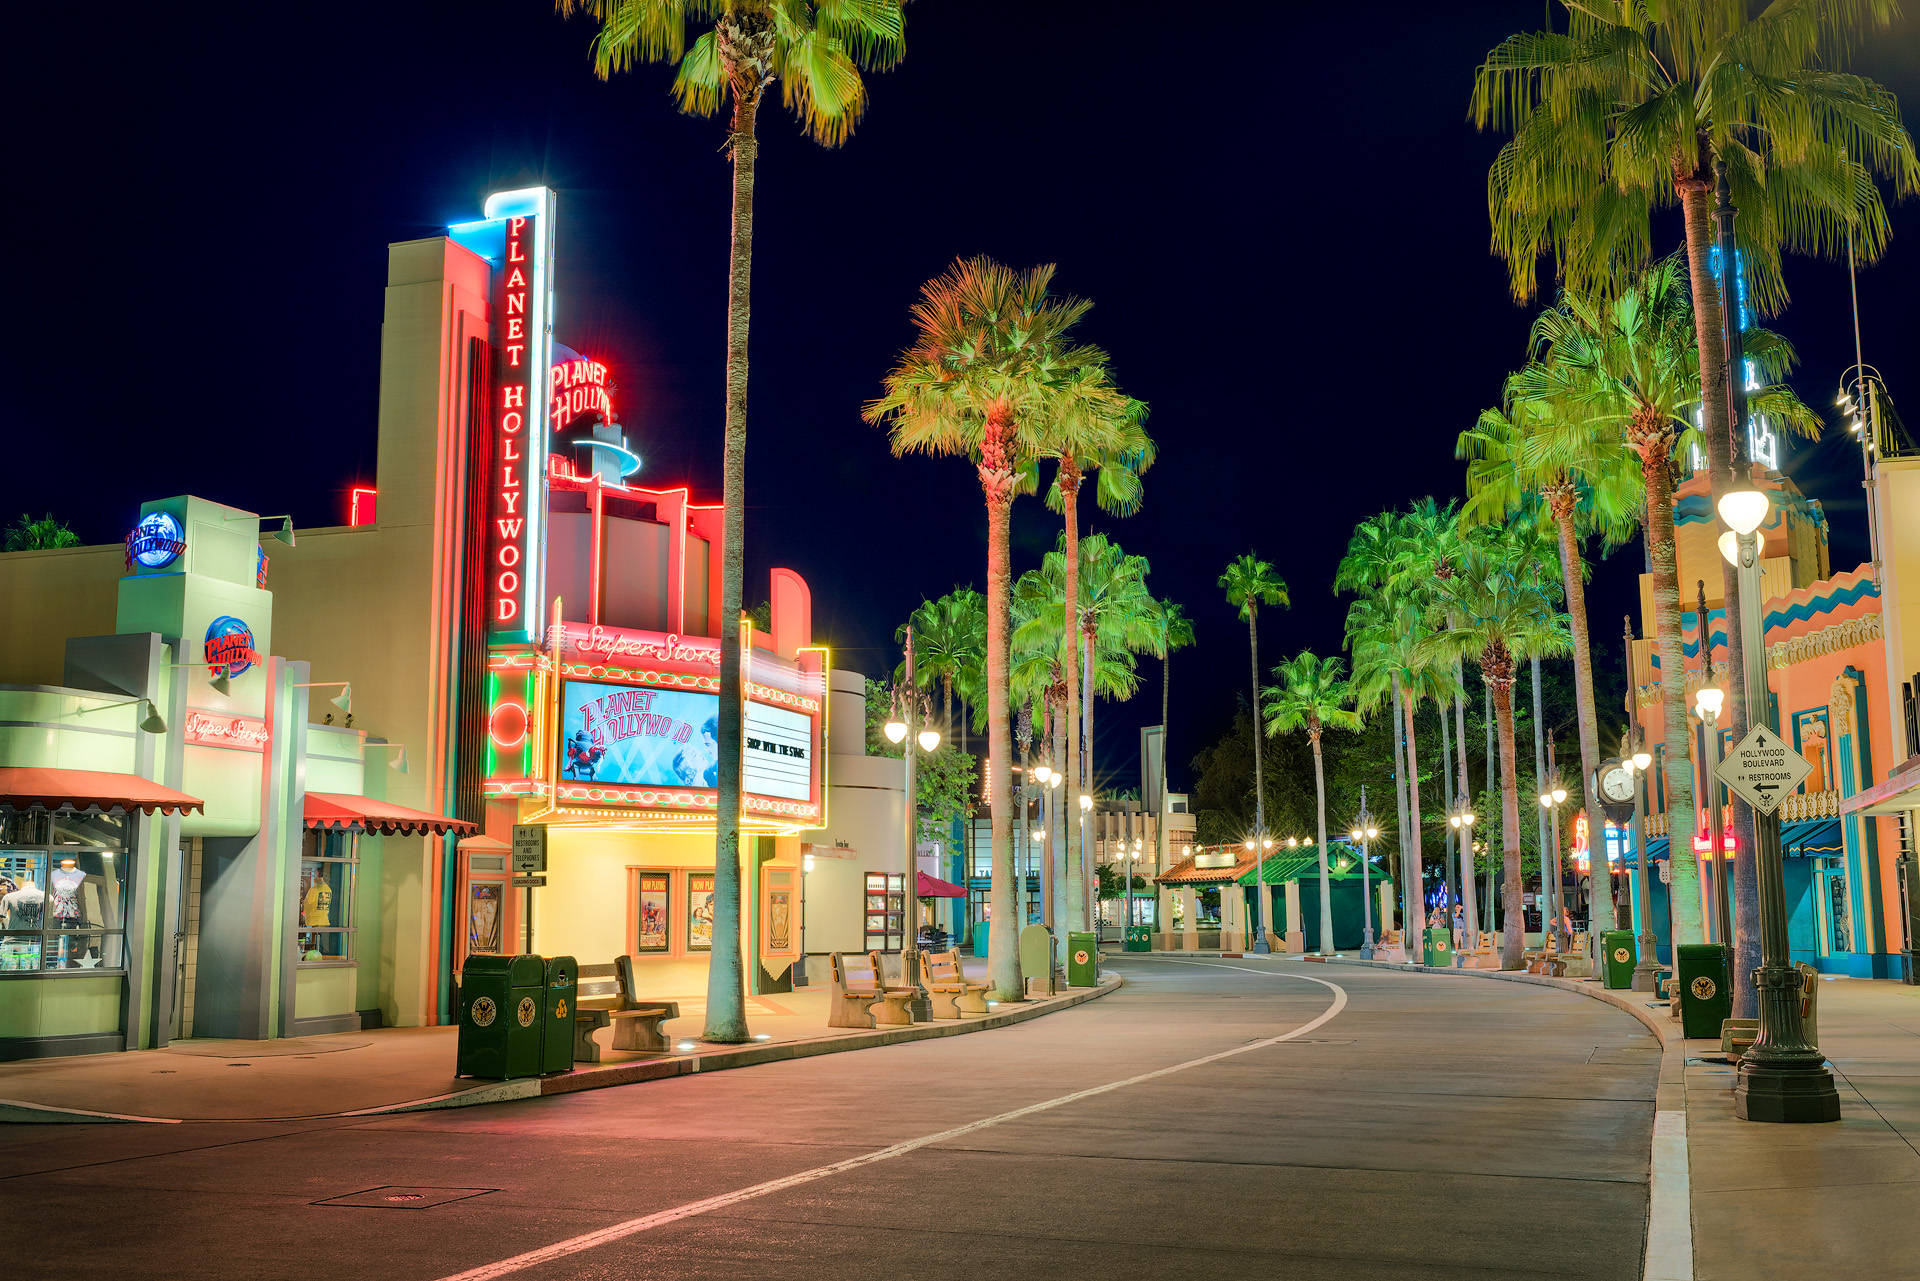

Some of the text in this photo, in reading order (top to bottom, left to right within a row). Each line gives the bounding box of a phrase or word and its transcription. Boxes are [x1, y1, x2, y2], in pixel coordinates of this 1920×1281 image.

[506, 215, 527, 366] PLANET
[550, 360, 608, 404] PLANET
[497, 384, 524, 620] HOLLYWOOD
[205, 632, 252, 664] PLANET
[577, 624, 658, 661] Super
[579, 690, 657, 731] PLANET
[186, 713, 231, 741] Super
[589, 712, 693, 747] HOLLYWOOD
[1740, 748, 1785, 758] HOLLYWOOD
[1742, 759, 1785, 768] BOULEVARD
[1748, 772, 1792, 781] RESTROOMS
[515, 839, 540, 847] RESTROOMS
[515, 854, 540, 862] TELEPHONES
[642, 880, 666, 890] NOW PLAYING
[693, 880, 704, 890] NOW
